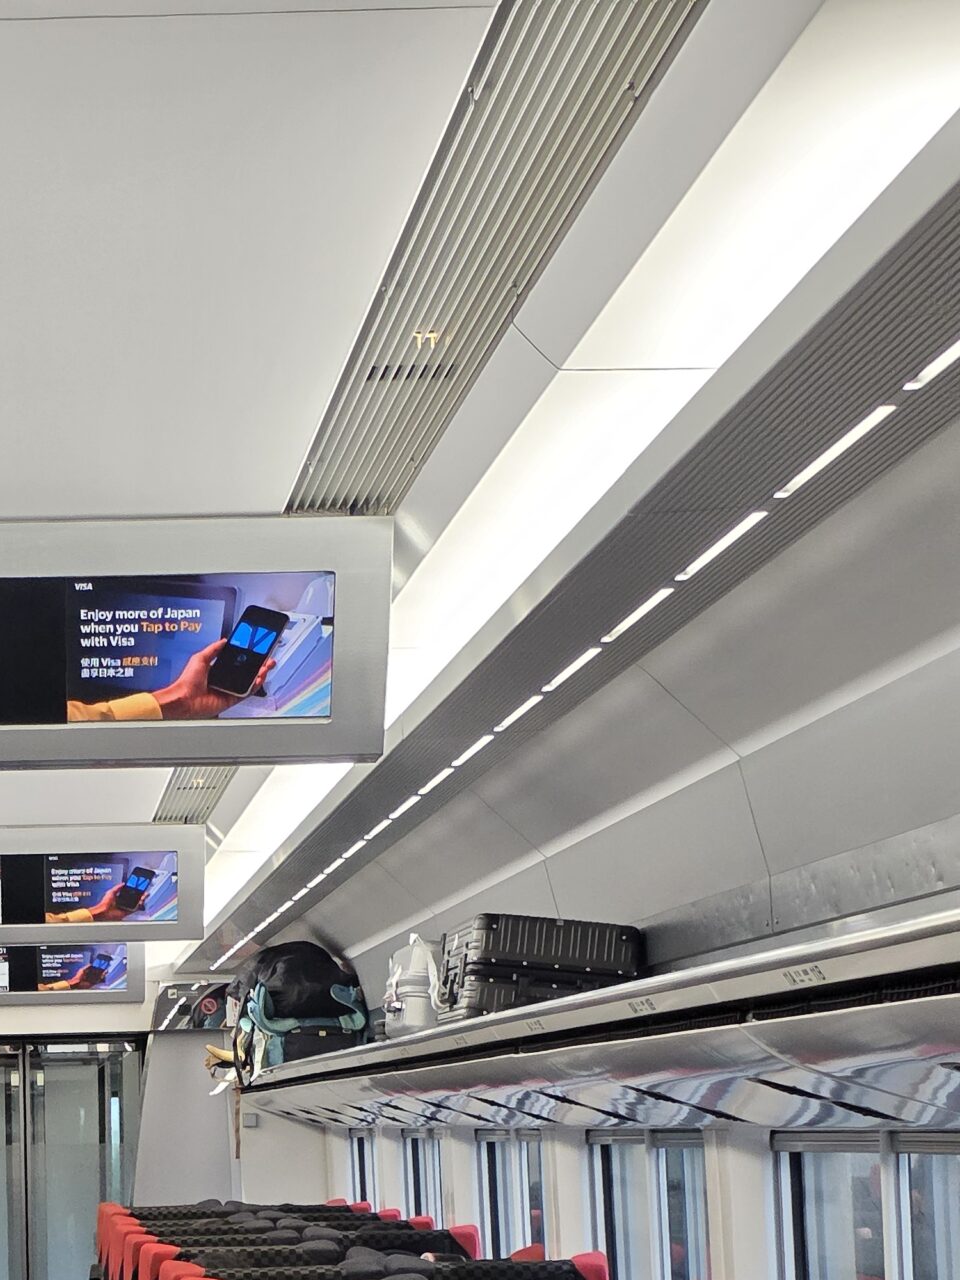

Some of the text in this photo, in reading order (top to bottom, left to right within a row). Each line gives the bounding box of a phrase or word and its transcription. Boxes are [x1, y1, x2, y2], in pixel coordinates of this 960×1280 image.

[80, 608, 201, 621] Enjoy more of Japan
[80, 621, 202, 634] when you Tap to Pay
[80, 636, 135, 647] with Visa
[101, 658, 121, 667] Visa
